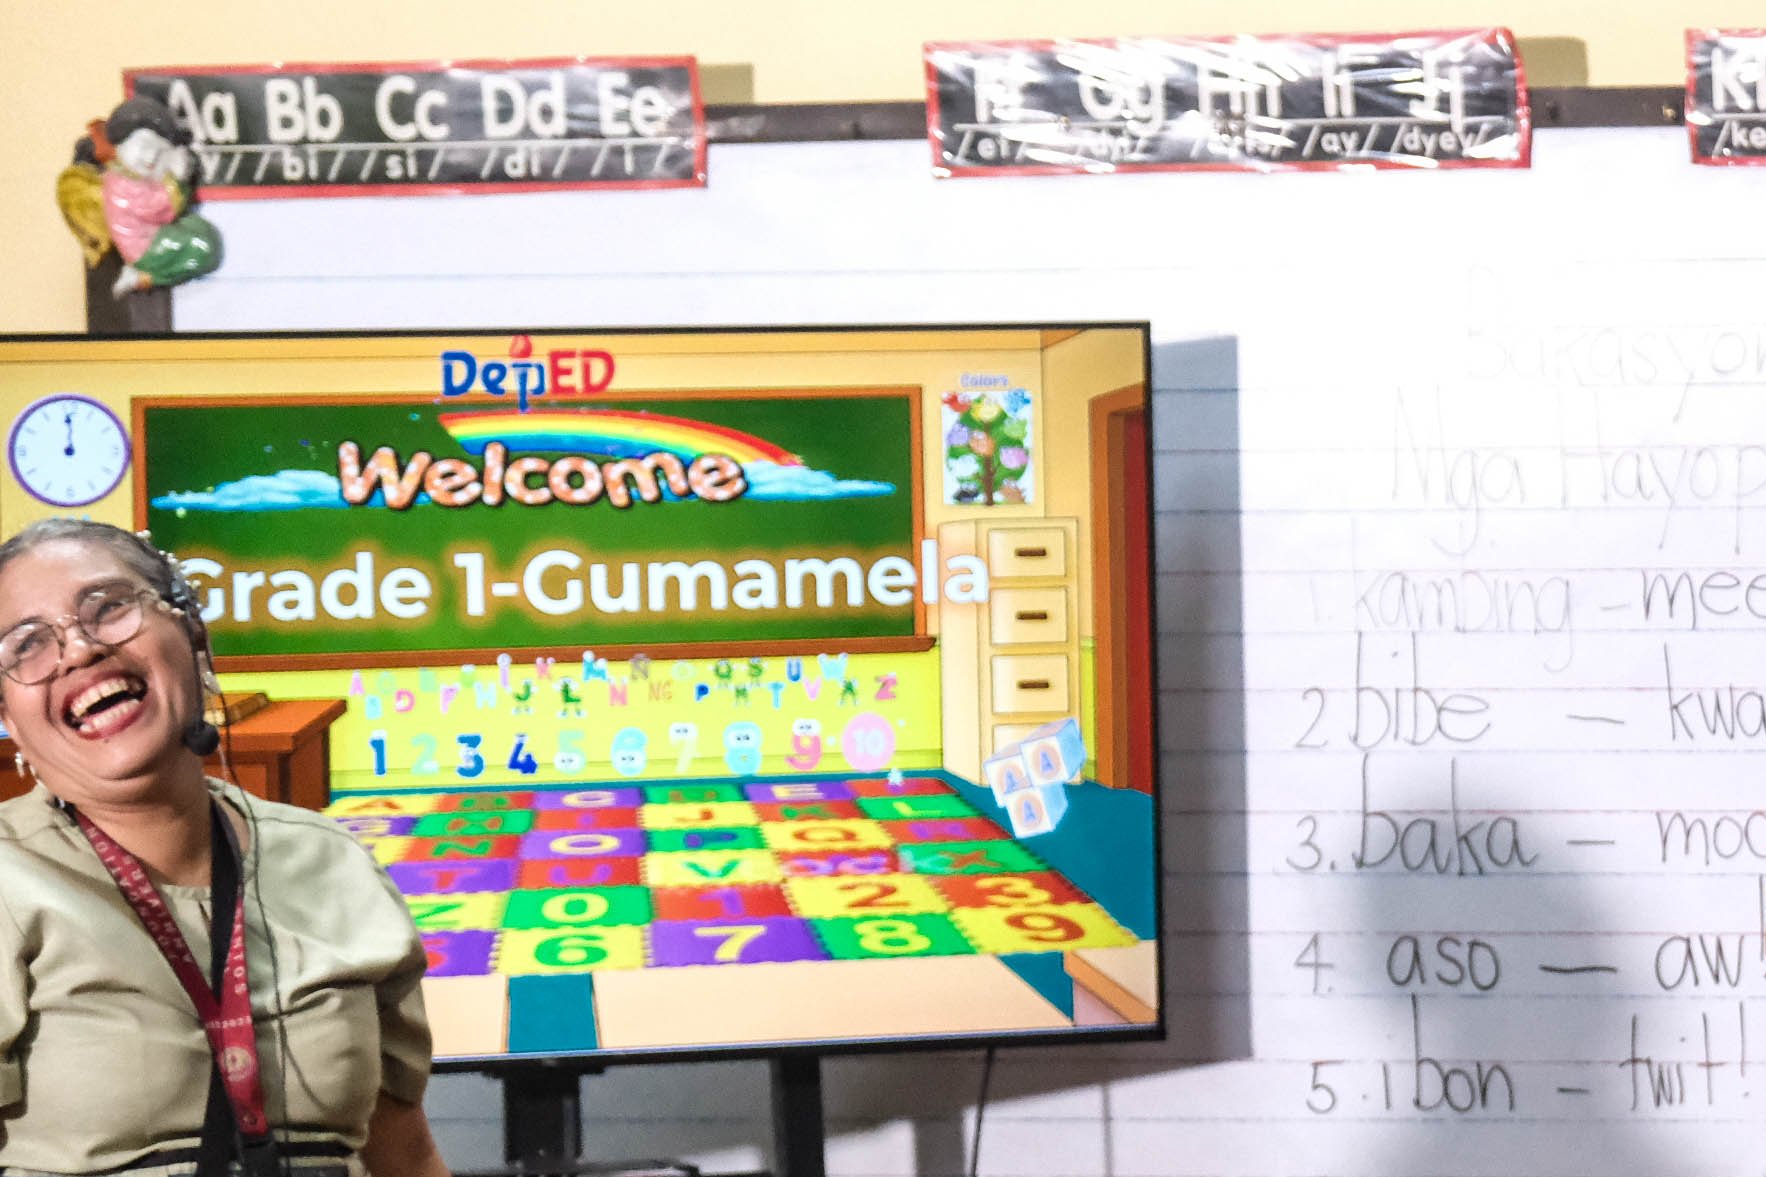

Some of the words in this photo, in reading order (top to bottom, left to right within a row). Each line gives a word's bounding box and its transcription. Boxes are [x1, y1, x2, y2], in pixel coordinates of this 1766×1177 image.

[266, 78, 344, 142] Bb
[376, 76, 449, 140] Cc
[482, 72, 565, 139] Dd
[599, 72, 670, 136] Ee
[441, 348, 616, 413] DepED
[338, 441, 749, 510] Welcome
[179, 551, 432, 621] Grade
[453, 538, 988, 616] 1-Gumamela
[1349, 630, 1492, 751] bibe
[1352, 753, 1538, 877] baka
[1386, 934, 1500, 990] aso
[1619, 1000, 1753, 1112] twit!
